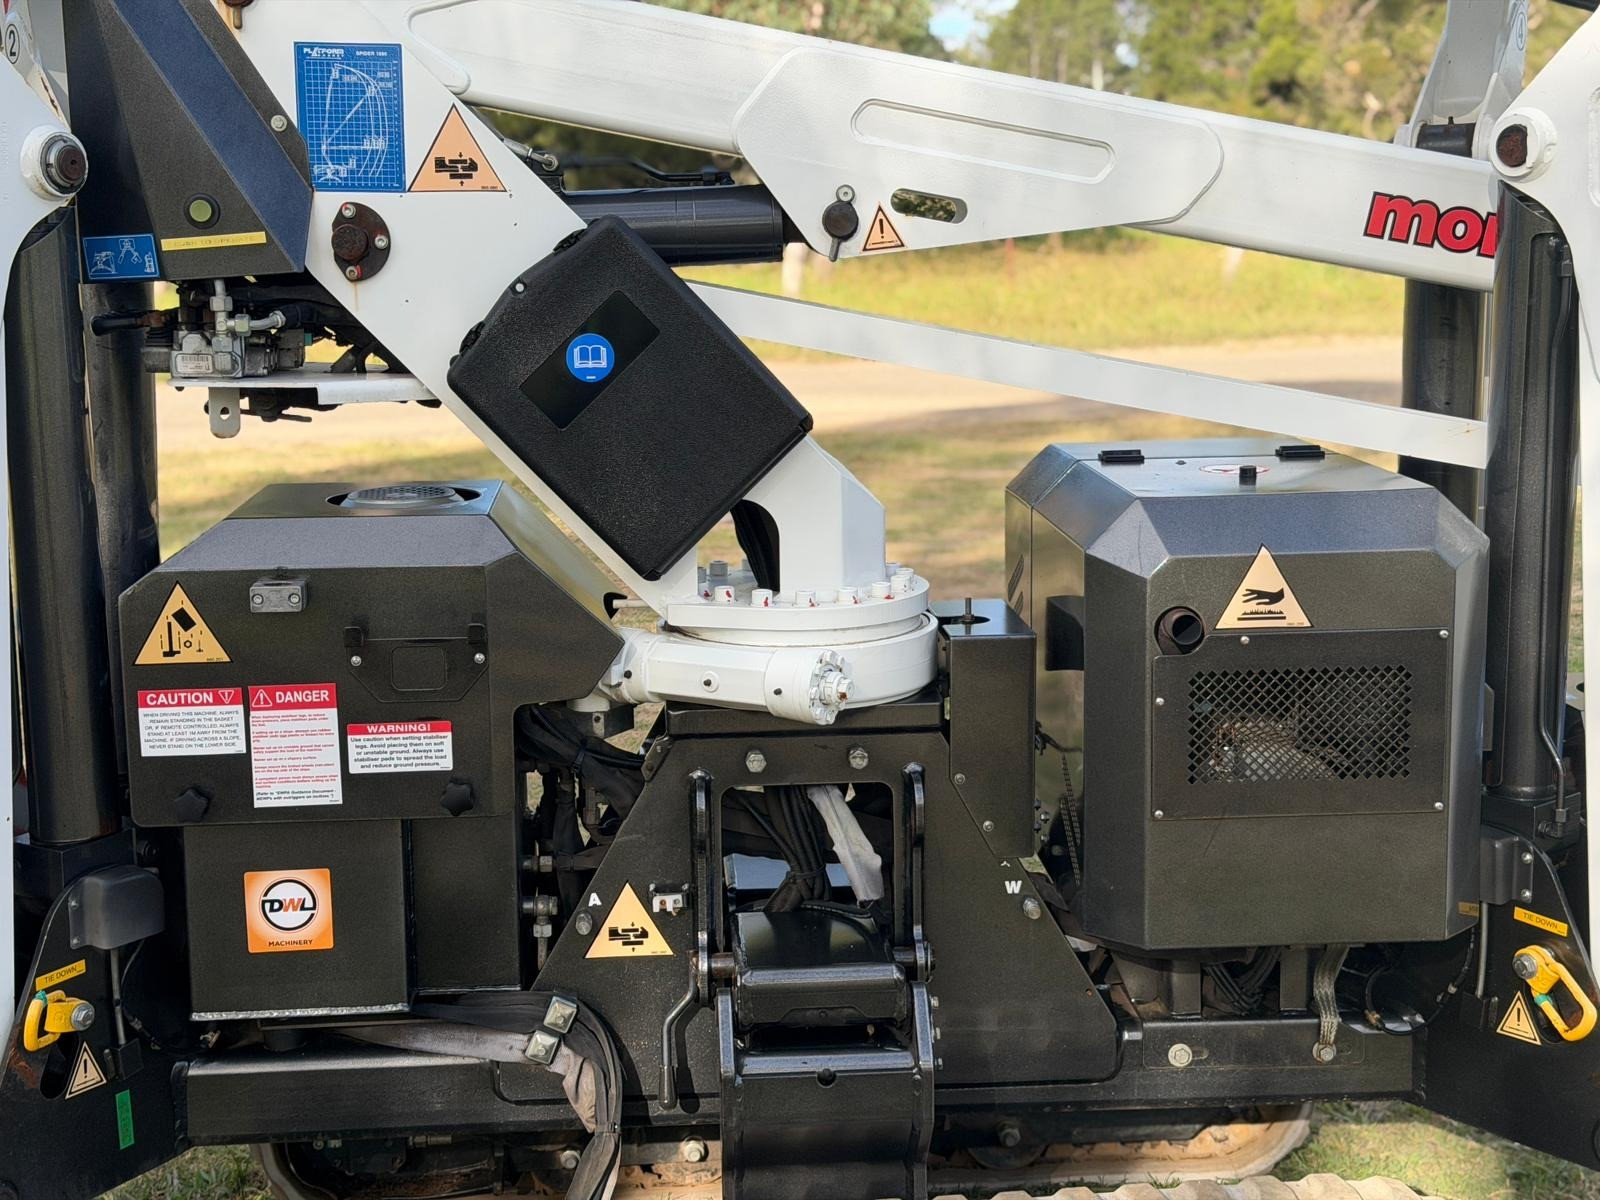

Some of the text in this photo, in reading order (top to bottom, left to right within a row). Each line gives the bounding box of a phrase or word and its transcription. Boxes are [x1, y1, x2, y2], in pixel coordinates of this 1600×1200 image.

[9, 30, 16, 56] 2
[147, 692, 213, 705] CAUTION
[276, 690, 329, 703] DANGER
[367, 724, 431, 733] WARNING!
[1005, 880, 1022, 894] W
[263, 898, 315, 912] DWL
[588, 892, 602, 906] A
[1523, 912, 1558, 929] TIE DOWN
[45, 965, 76, 983] TIE DOWN
